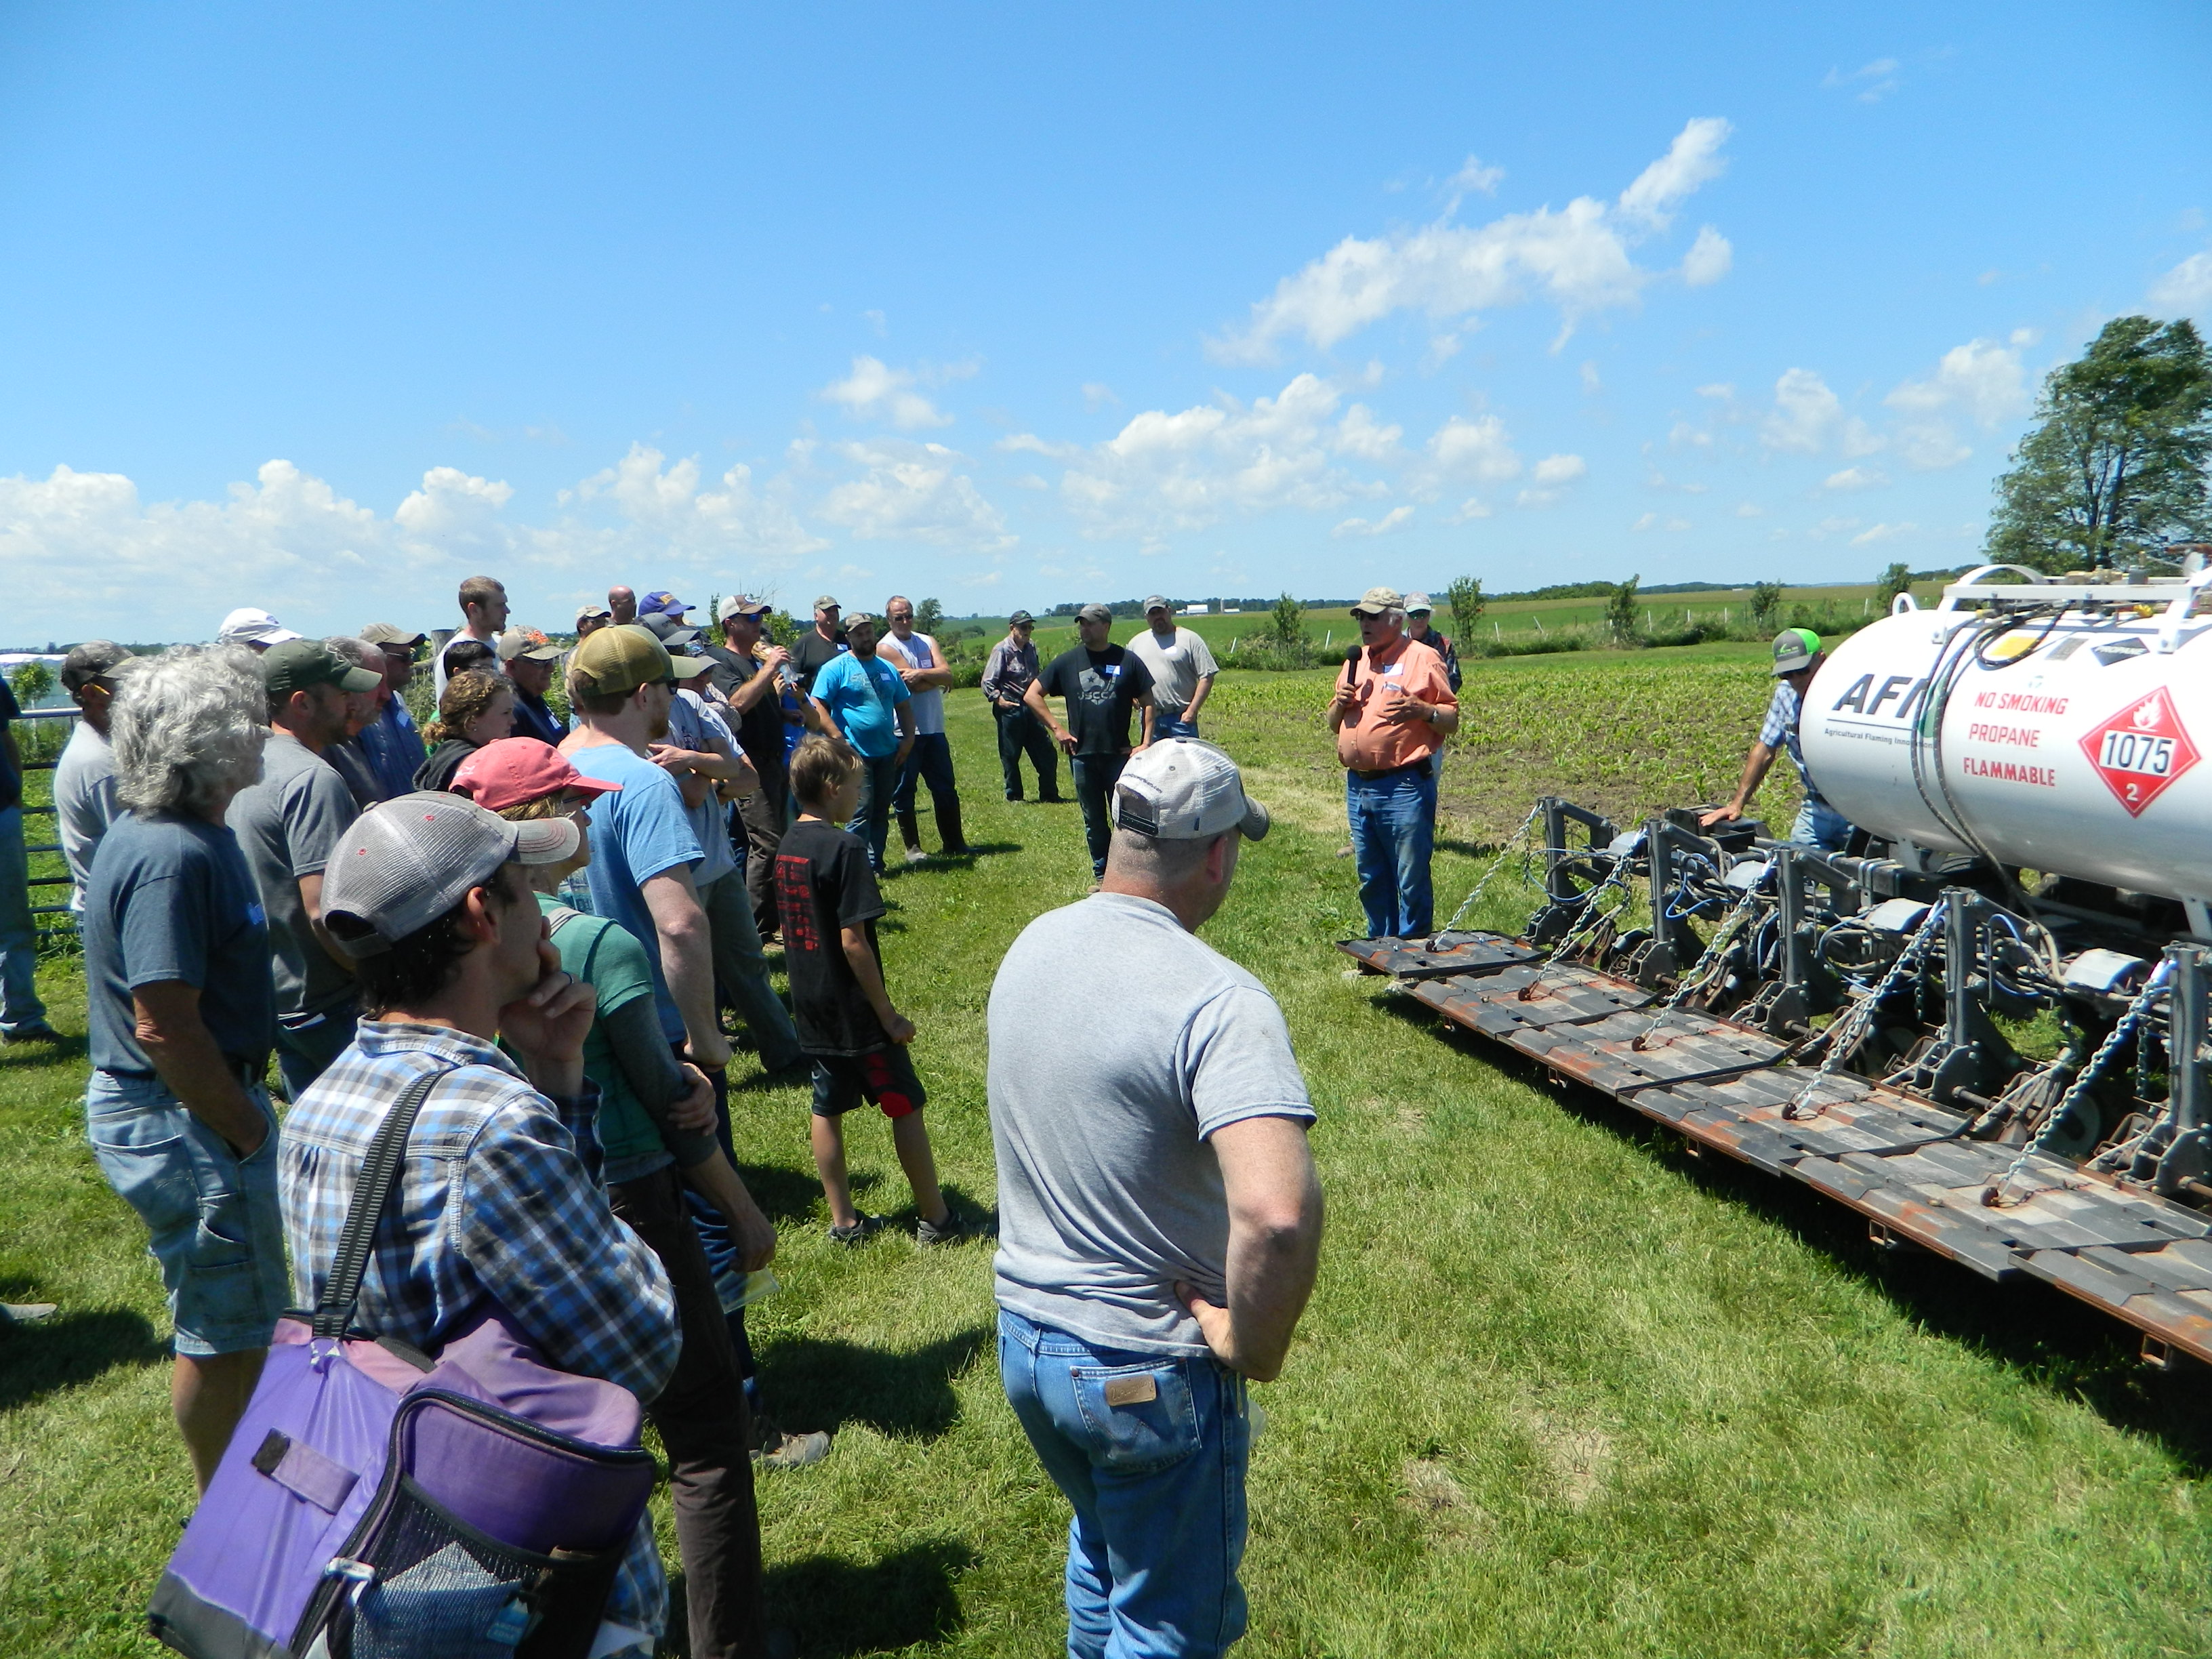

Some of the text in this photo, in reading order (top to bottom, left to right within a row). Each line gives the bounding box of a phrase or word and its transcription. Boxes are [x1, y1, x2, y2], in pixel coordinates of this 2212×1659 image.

[1974, 691, 2069, 714] NO SMOKING
[1824, 728, 1863, 739] Agricultural
[1865, 733, 1892, 745] Flaming
[1969, 723, 2040, 747] PROPANE
[2108, 733, 2172, 773] 1075
[1963, 757, 2055, 786] FLAMMABLE
[2126, 783, 2139, 802] 2
